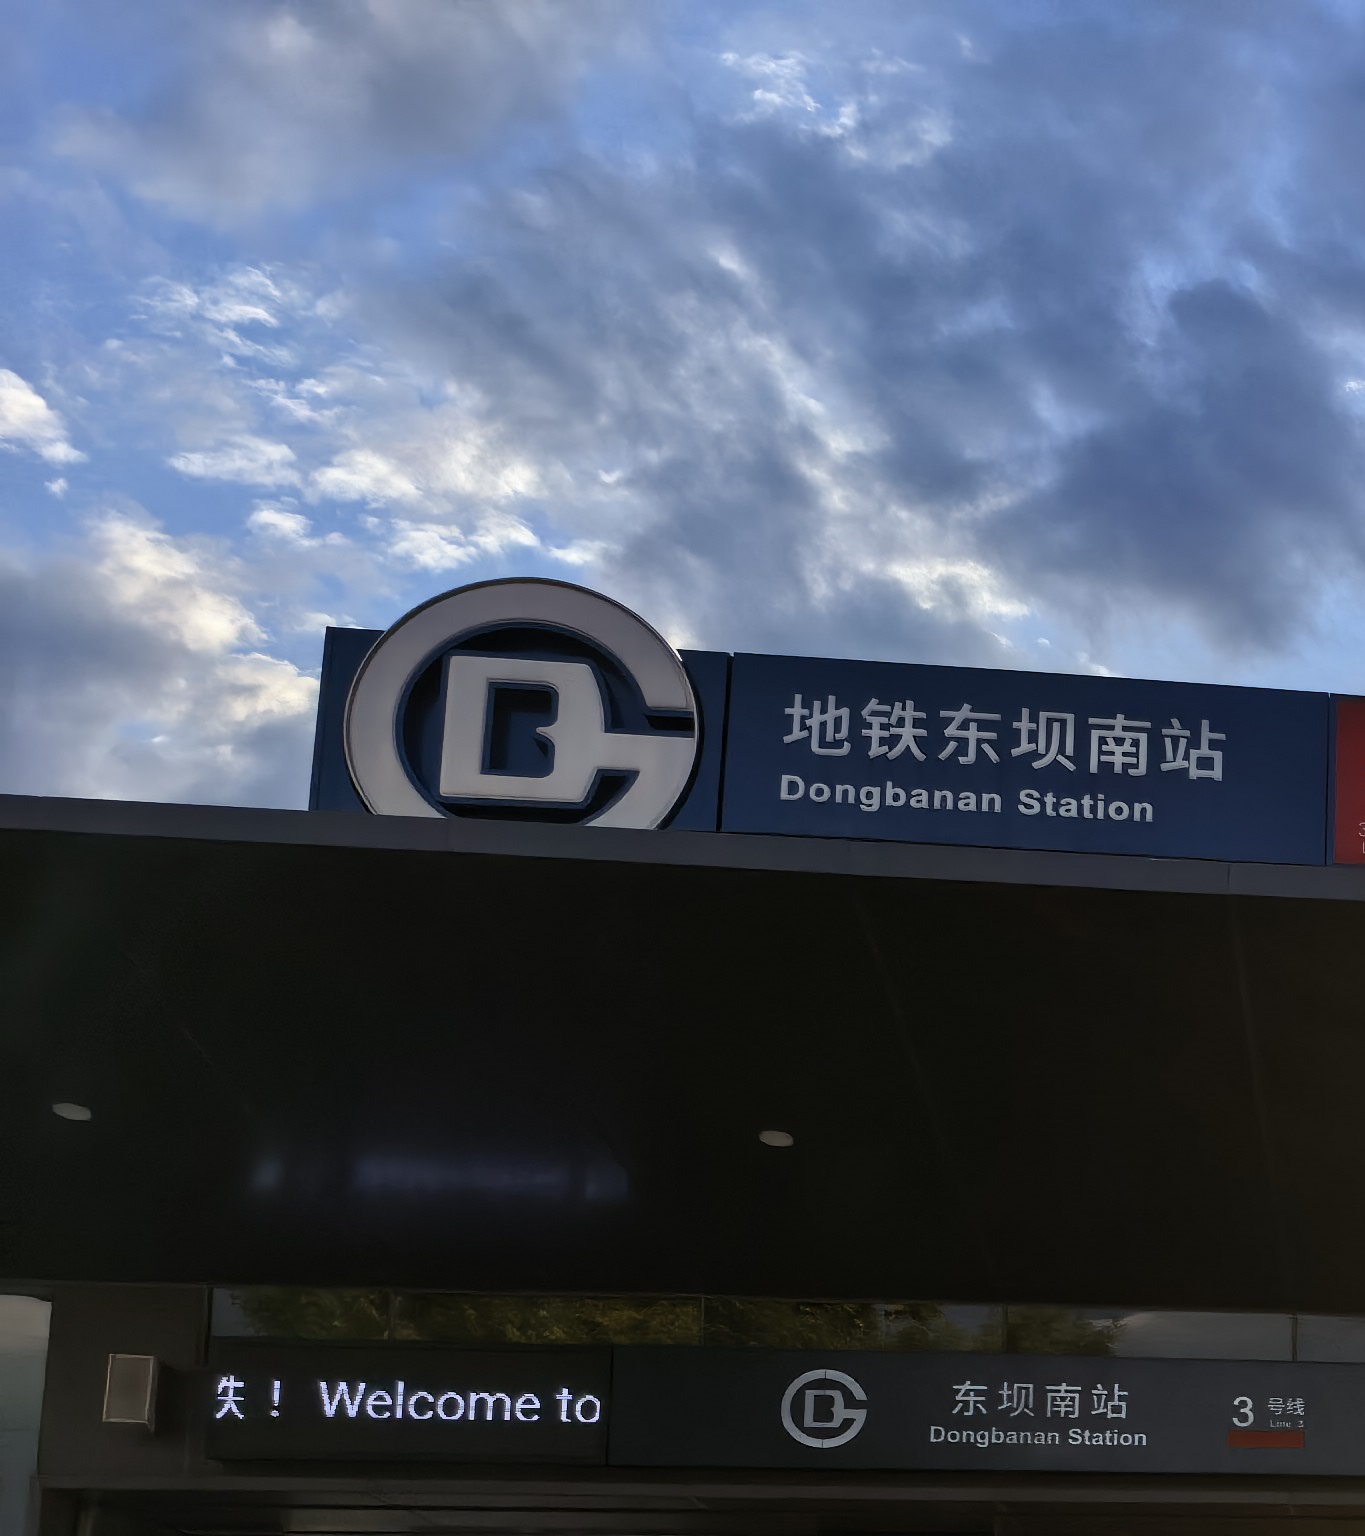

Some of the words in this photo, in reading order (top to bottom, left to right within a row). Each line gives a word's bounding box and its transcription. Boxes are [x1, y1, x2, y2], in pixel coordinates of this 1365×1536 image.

[782, 692, 1228, 782] 地铁东坝南站
[780, 774, 1002, 813] Dongbanan
[1017, 789, 1154, 823] Station
[318, 1379, 541, 1422] Welcome
[555, 1386, 601, 1423] to
[952, 1380, 1130, 1419] 东坝南站
[1232, 1396, 1254, 1427] 3
[1267, 1397, 1305, 1416] 号线
[929, 1425, 1060, 1448] Dongbanan
[1068, 1427, 1147, 1447] Station
